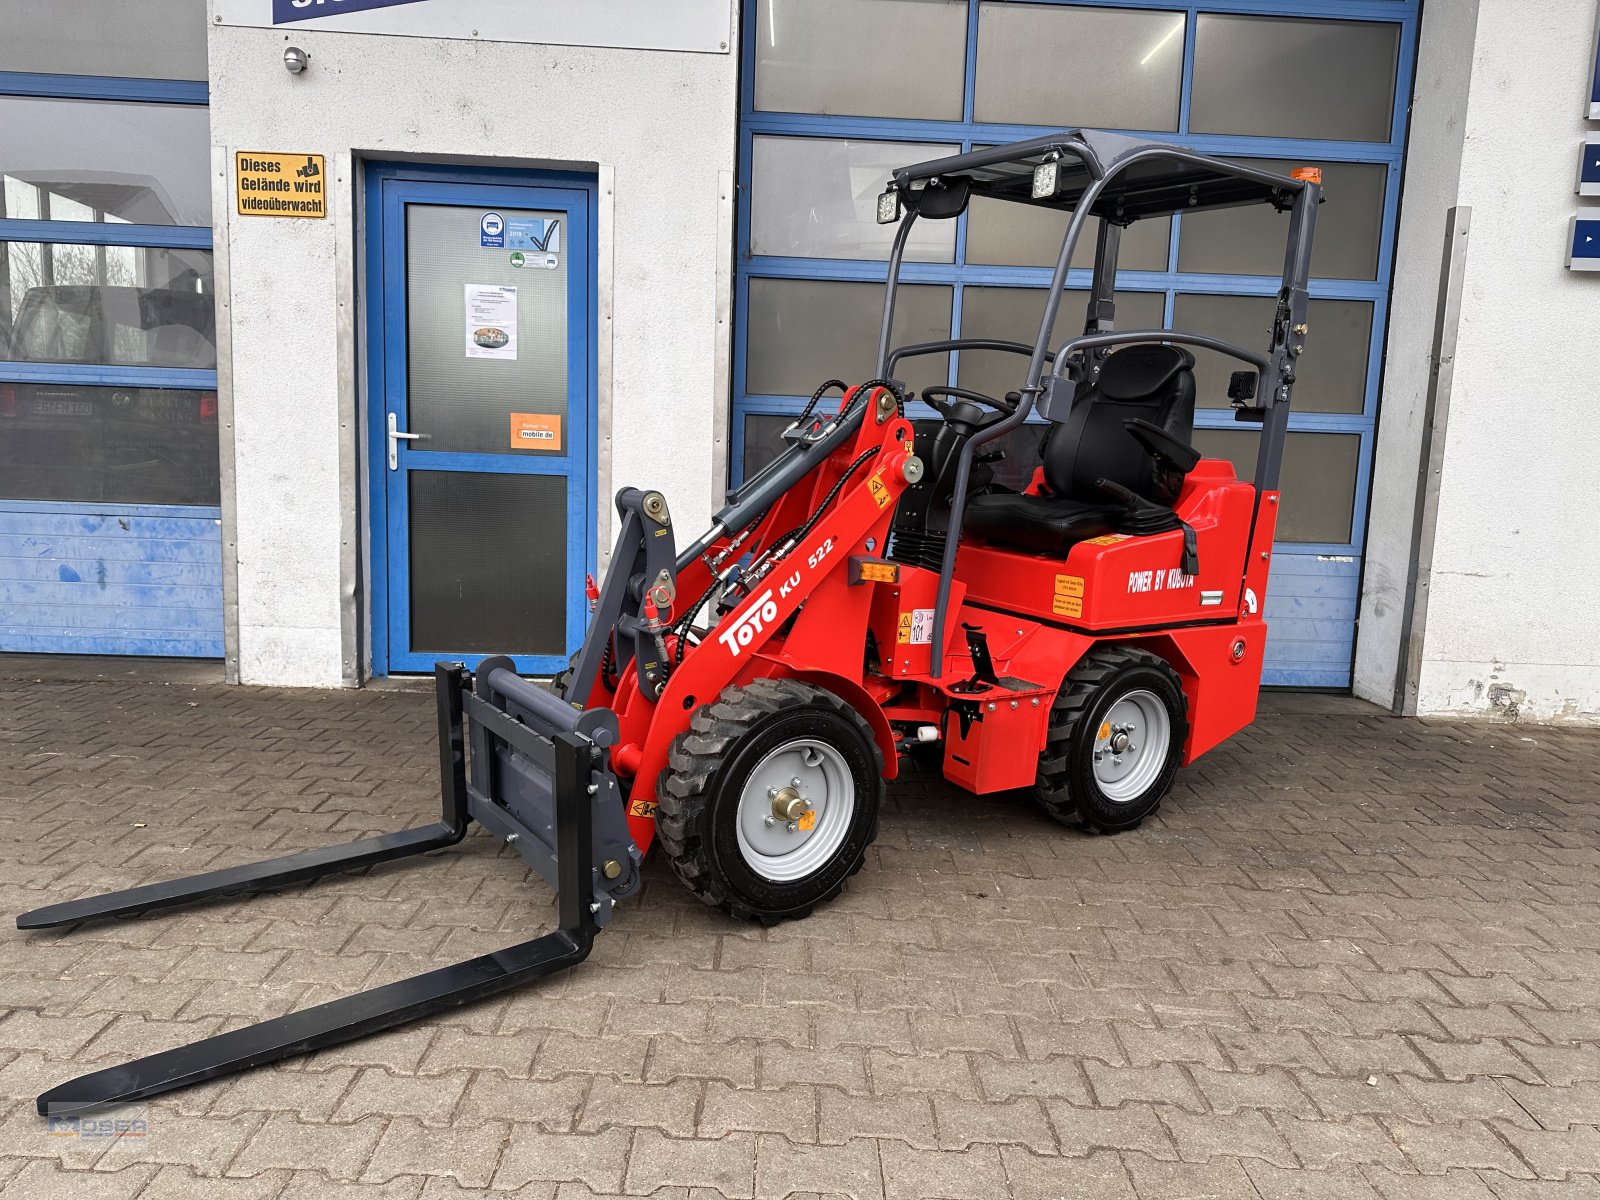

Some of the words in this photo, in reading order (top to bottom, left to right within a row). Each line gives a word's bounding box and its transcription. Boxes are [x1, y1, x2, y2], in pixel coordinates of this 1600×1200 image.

[240, 158, 281, 173] Dieses
[241, 177, 290, 192] Gelände
[294, 180, 321, 193] wird
[241, 196, 322, 213] videoüberwacht
[1127, 570, 1153, 594] POWER
[1154, 569, 1166, 591] BY
[718, 588, 777, 657] TOYO
[779, 570, 801, 599] KU
[807, 538, 834, 569] 522
[912, 624, 924, 641] 101
